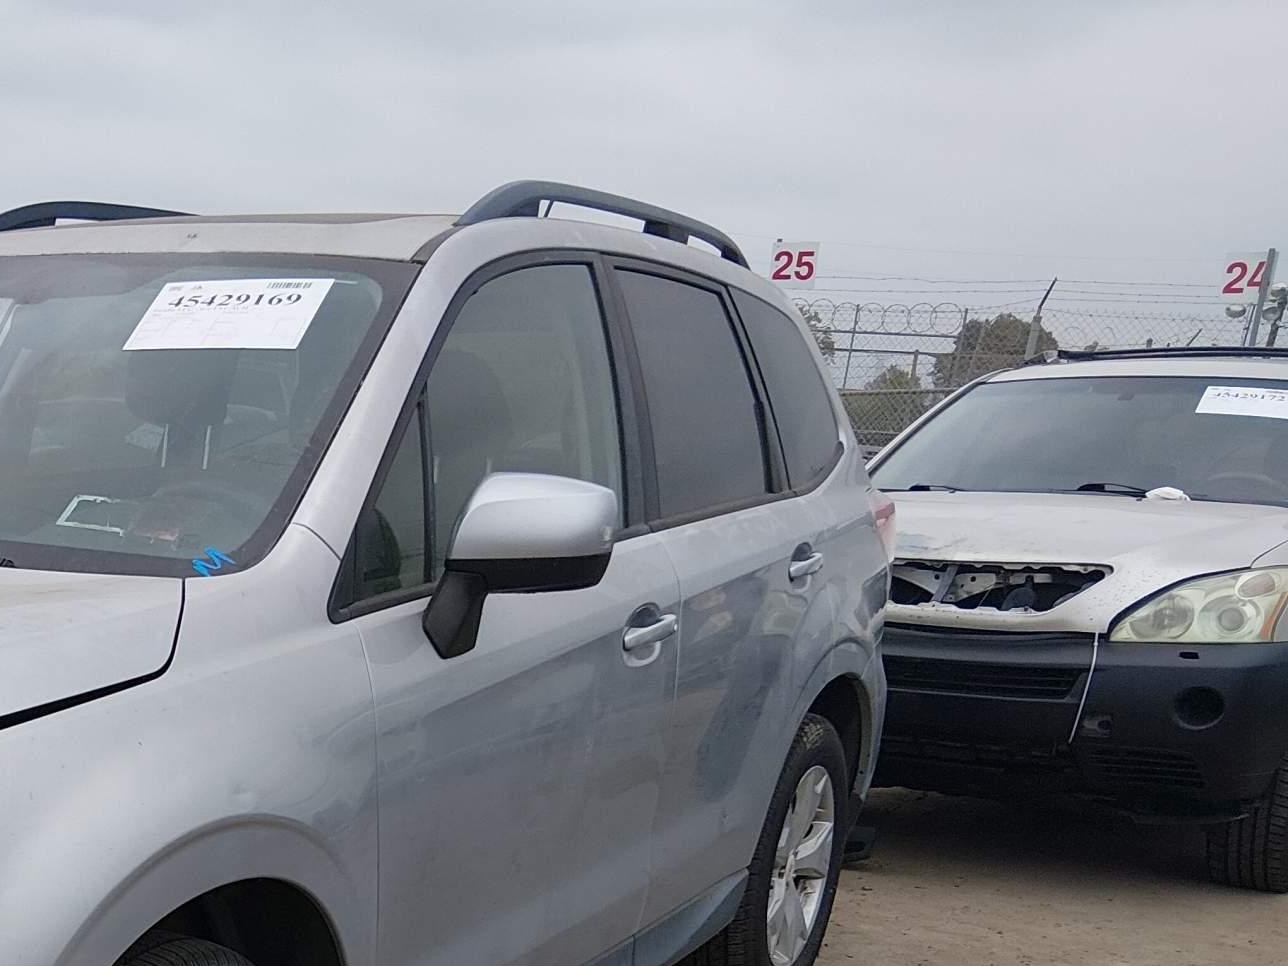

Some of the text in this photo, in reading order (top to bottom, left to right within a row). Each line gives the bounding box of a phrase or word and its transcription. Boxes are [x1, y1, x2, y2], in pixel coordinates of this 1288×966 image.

[772, 251, 814, 280] 25
[1222, 261, 1266, 294] 24
[168, 293, 302, 308] 45429169
